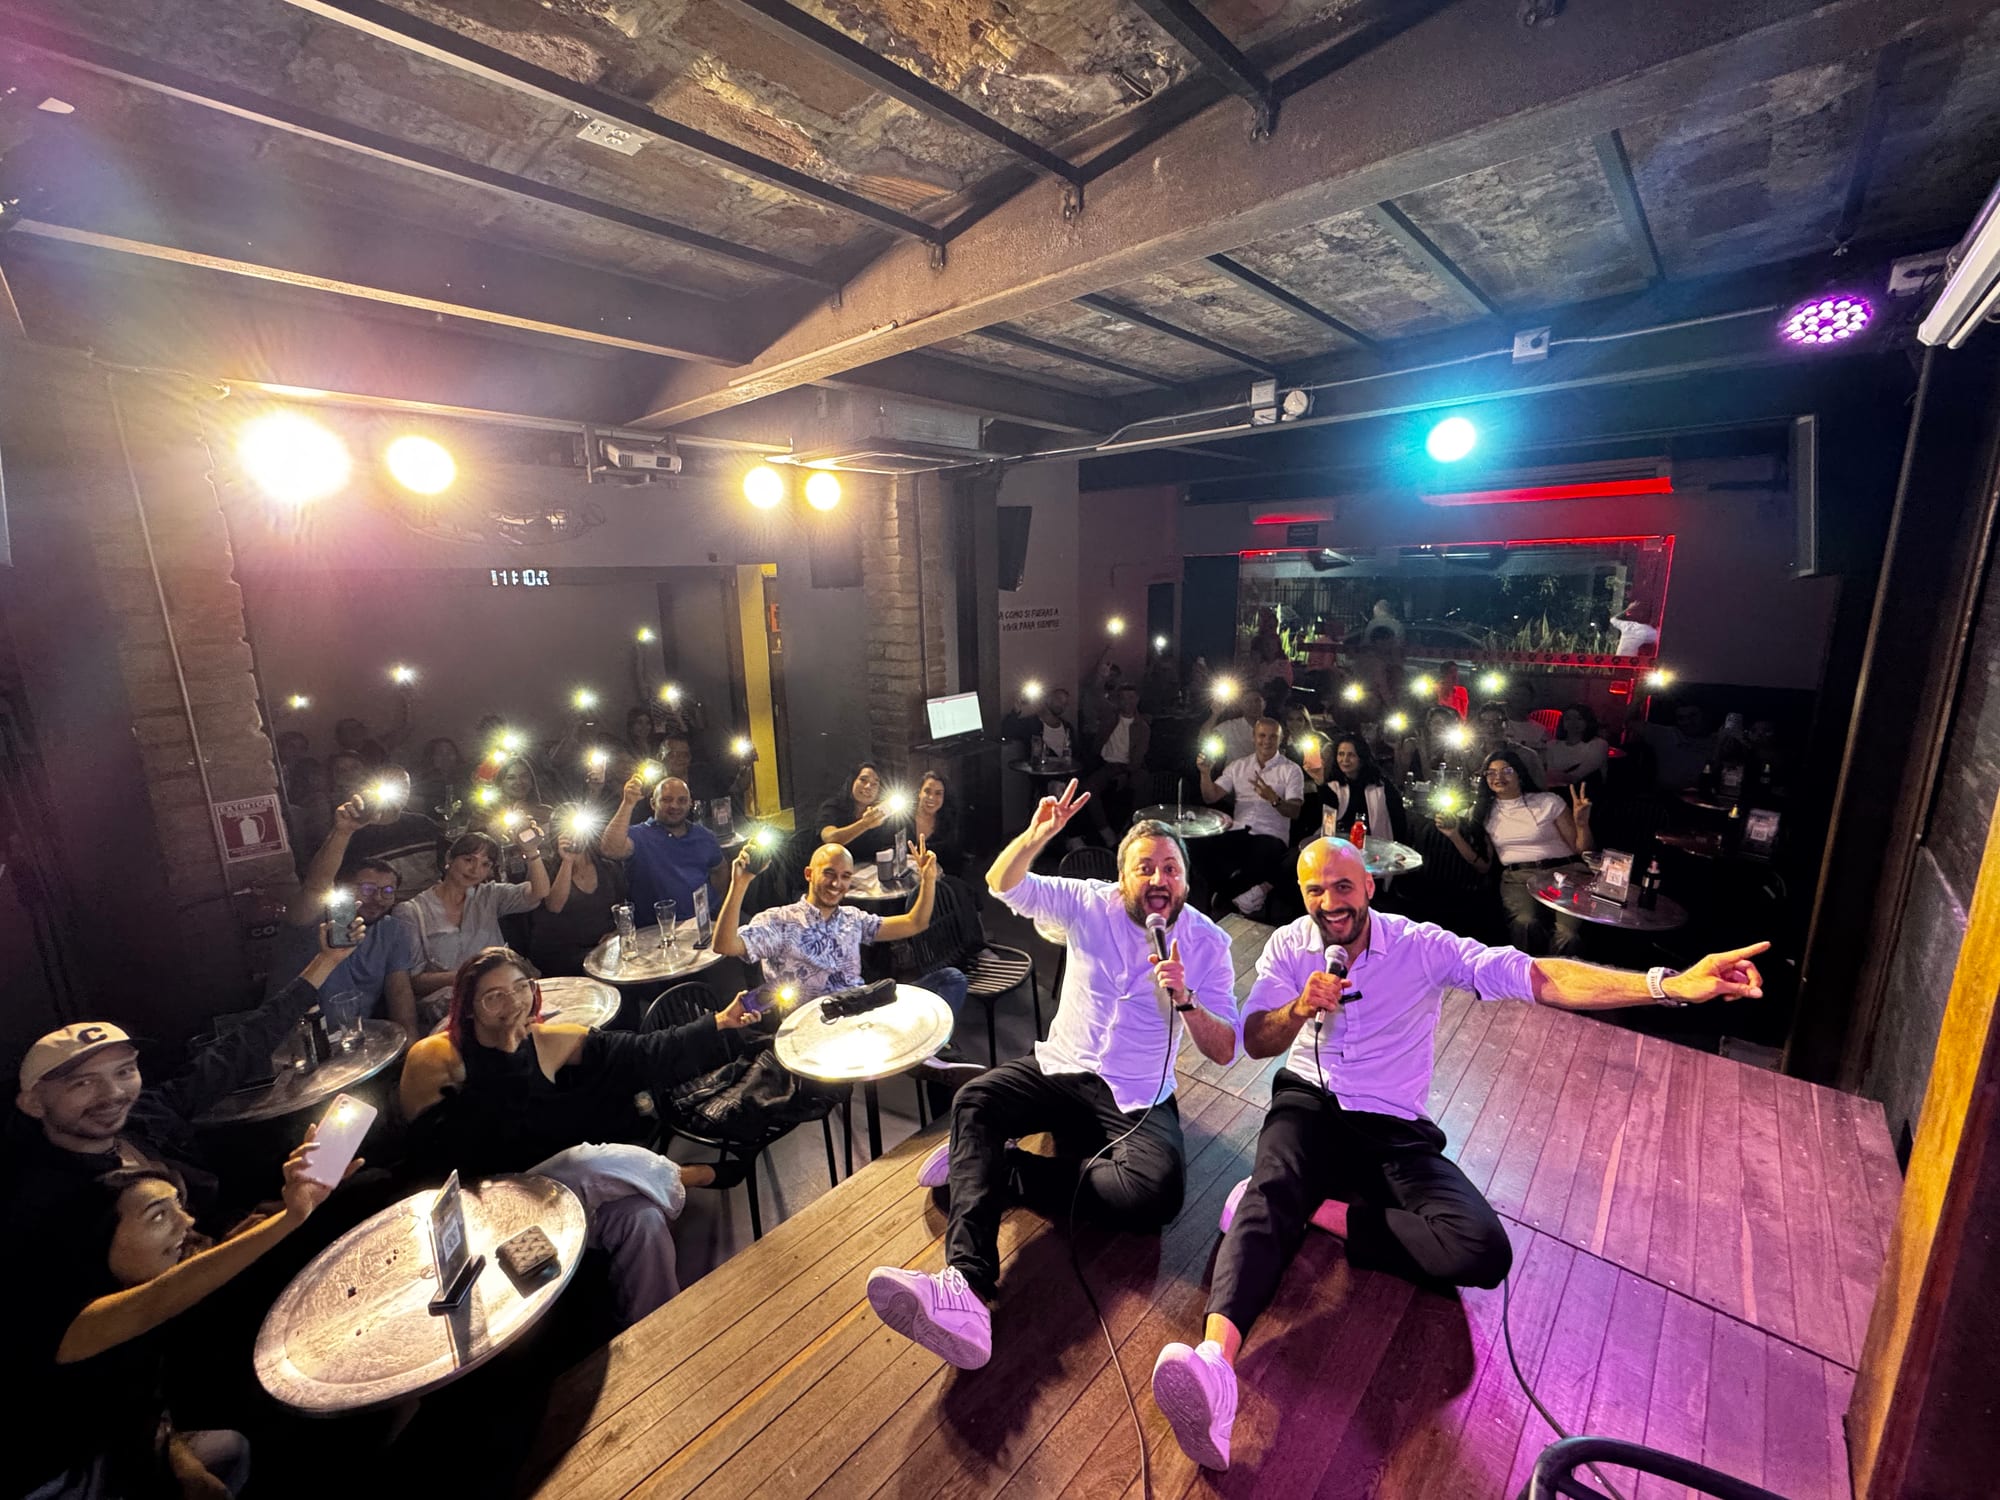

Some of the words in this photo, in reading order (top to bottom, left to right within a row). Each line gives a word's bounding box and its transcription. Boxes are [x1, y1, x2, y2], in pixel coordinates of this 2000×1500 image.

[1005, 610, 1023, 619] COMO
[218, 799, 273, 814] EXTINTOR
[77, 1026, 108, 1044] C
